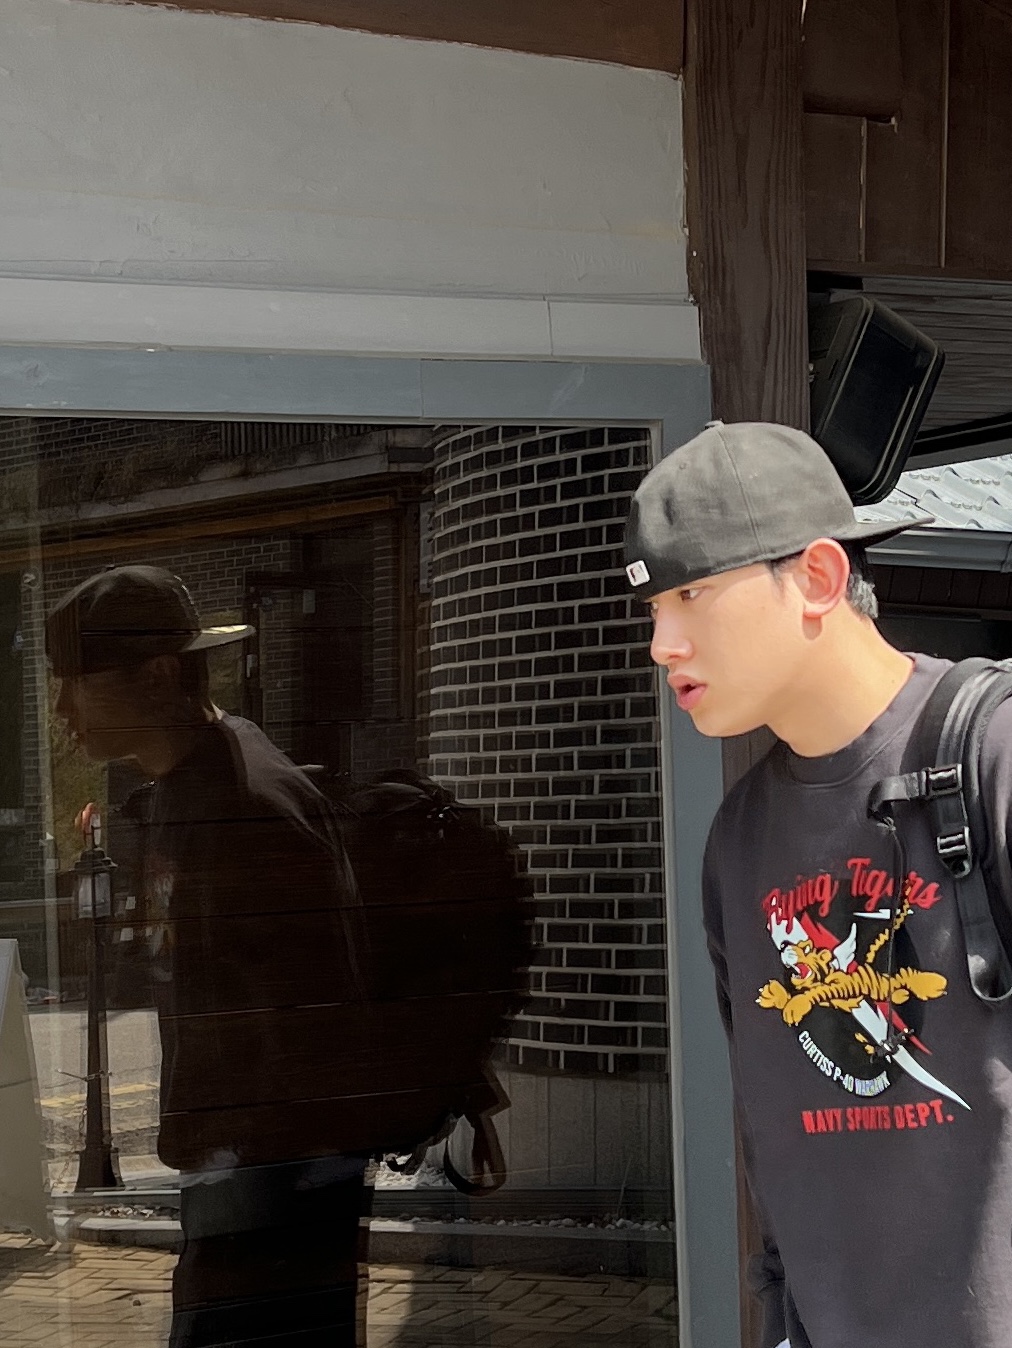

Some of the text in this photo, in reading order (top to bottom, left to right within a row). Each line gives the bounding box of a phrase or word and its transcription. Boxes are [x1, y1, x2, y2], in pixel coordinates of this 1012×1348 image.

[798, 1030, 834, 1077] CURTISS
[832, 1067, 855, 1093] P-40
[802, 1099, 955, 1134] NAVY SPORTS DEPT.
